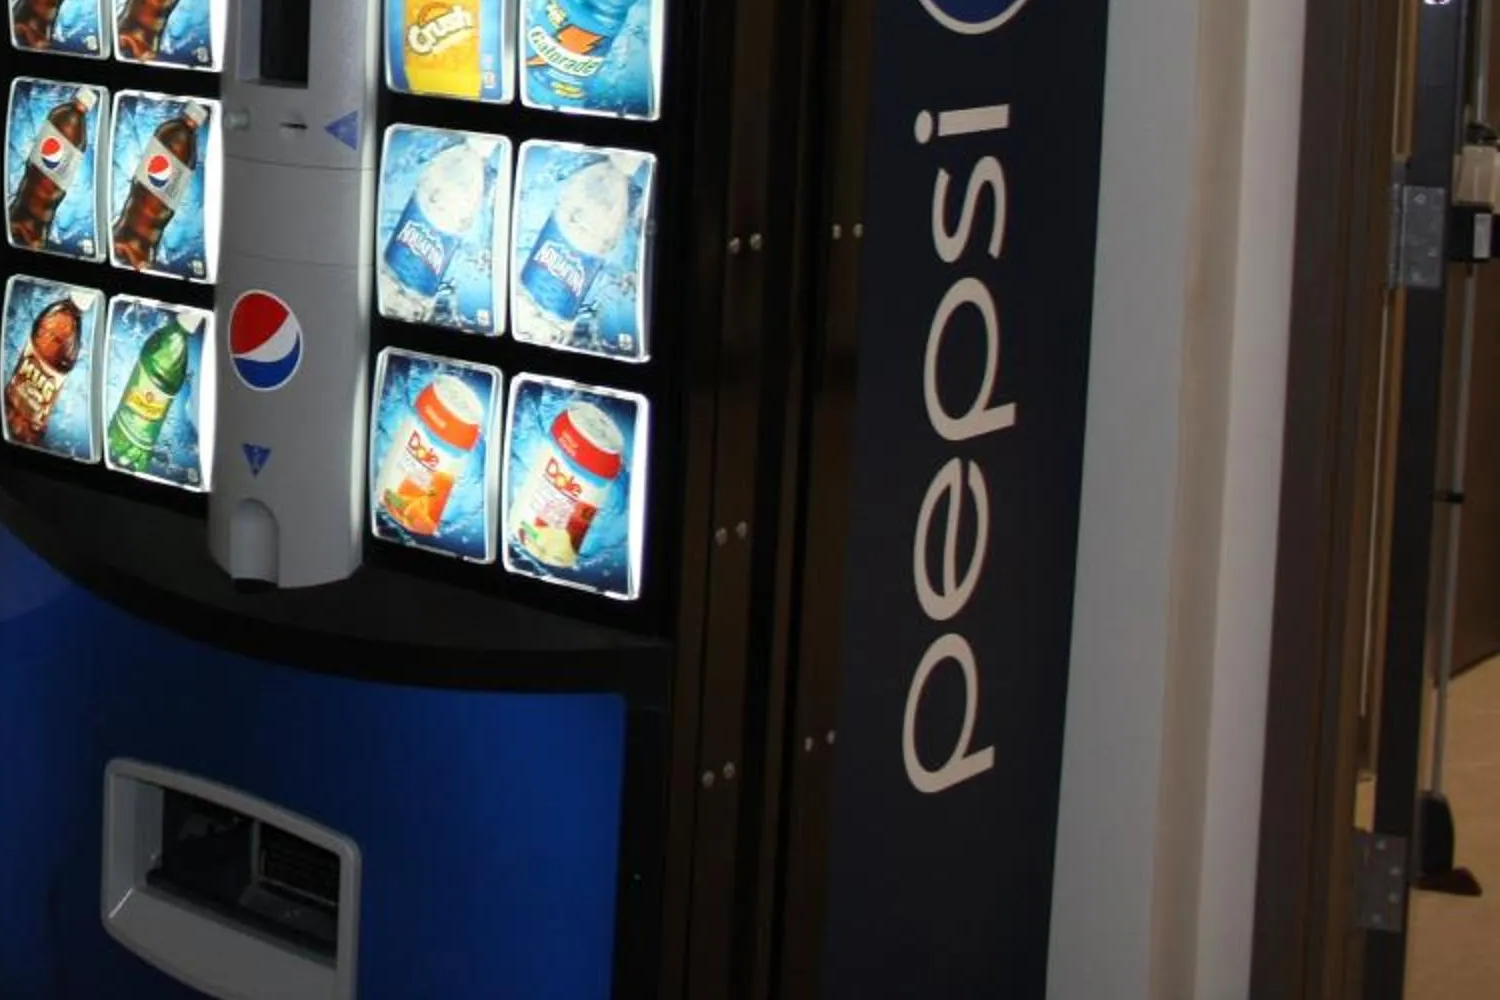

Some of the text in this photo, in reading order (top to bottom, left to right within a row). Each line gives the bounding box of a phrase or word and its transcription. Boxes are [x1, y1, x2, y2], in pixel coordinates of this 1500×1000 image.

[407, 429, 440, 468] Dole
[902, 104, 1017, 794] pepsi
[545, 456, 582, 498] Dole
